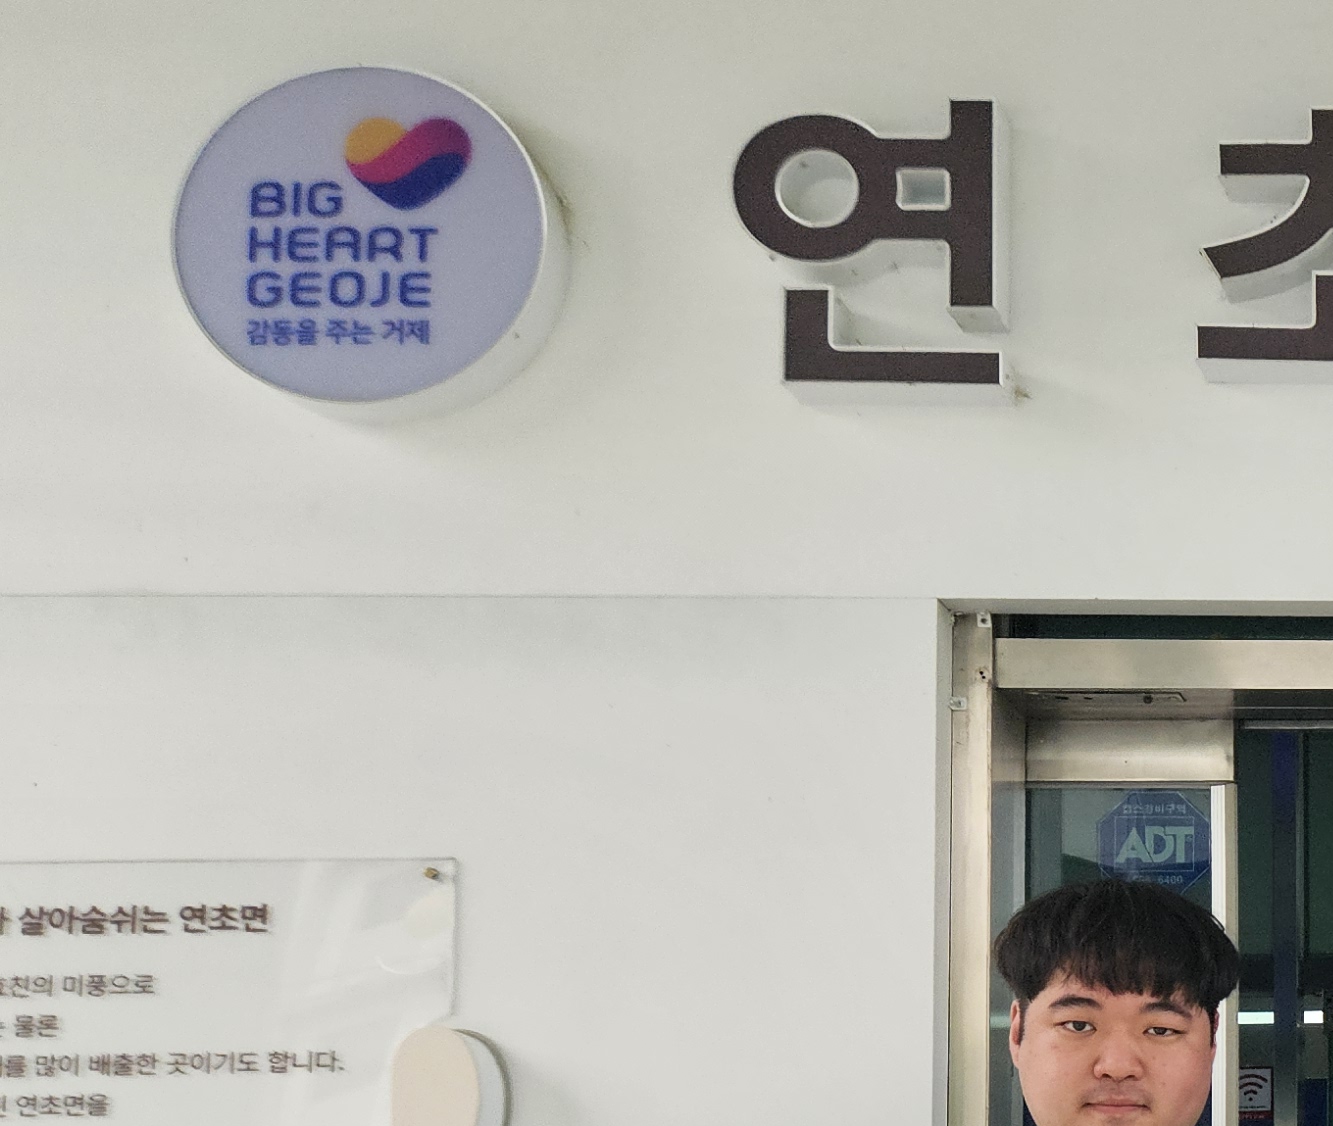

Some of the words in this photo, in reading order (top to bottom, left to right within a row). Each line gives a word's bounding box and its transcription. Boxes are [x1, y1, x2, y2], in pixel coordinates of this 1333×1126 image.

[249, 181, 344, 218] BIG
[247, 226, 439, 263] HEART
[246, 271, 432, 308] GEOJE
[247, 319, 318, 346] 감동을
[325, 319, 374, 345] 주는
[383, 319, 431, 345] 거제
[1115, 826, 1194, 863] ADT
[19, 904, 170, 935] 살아숨쉬는
[179, 903, 269, 933] 연초면
[62, 973, 155, 997] 미풍으로
[14, 1014, 59, 1038] 물론
[0, 1054, 27, 1079] 를
[36, 1053, 80, 1077] 많이
[89, 1053, 158, 1077] 배출한
[167, 1051, 260, 1076] 곳이기도
[268, 1050, 344, 1075] 합니다.
[16, 1093, 109, 1117] 연초면을
